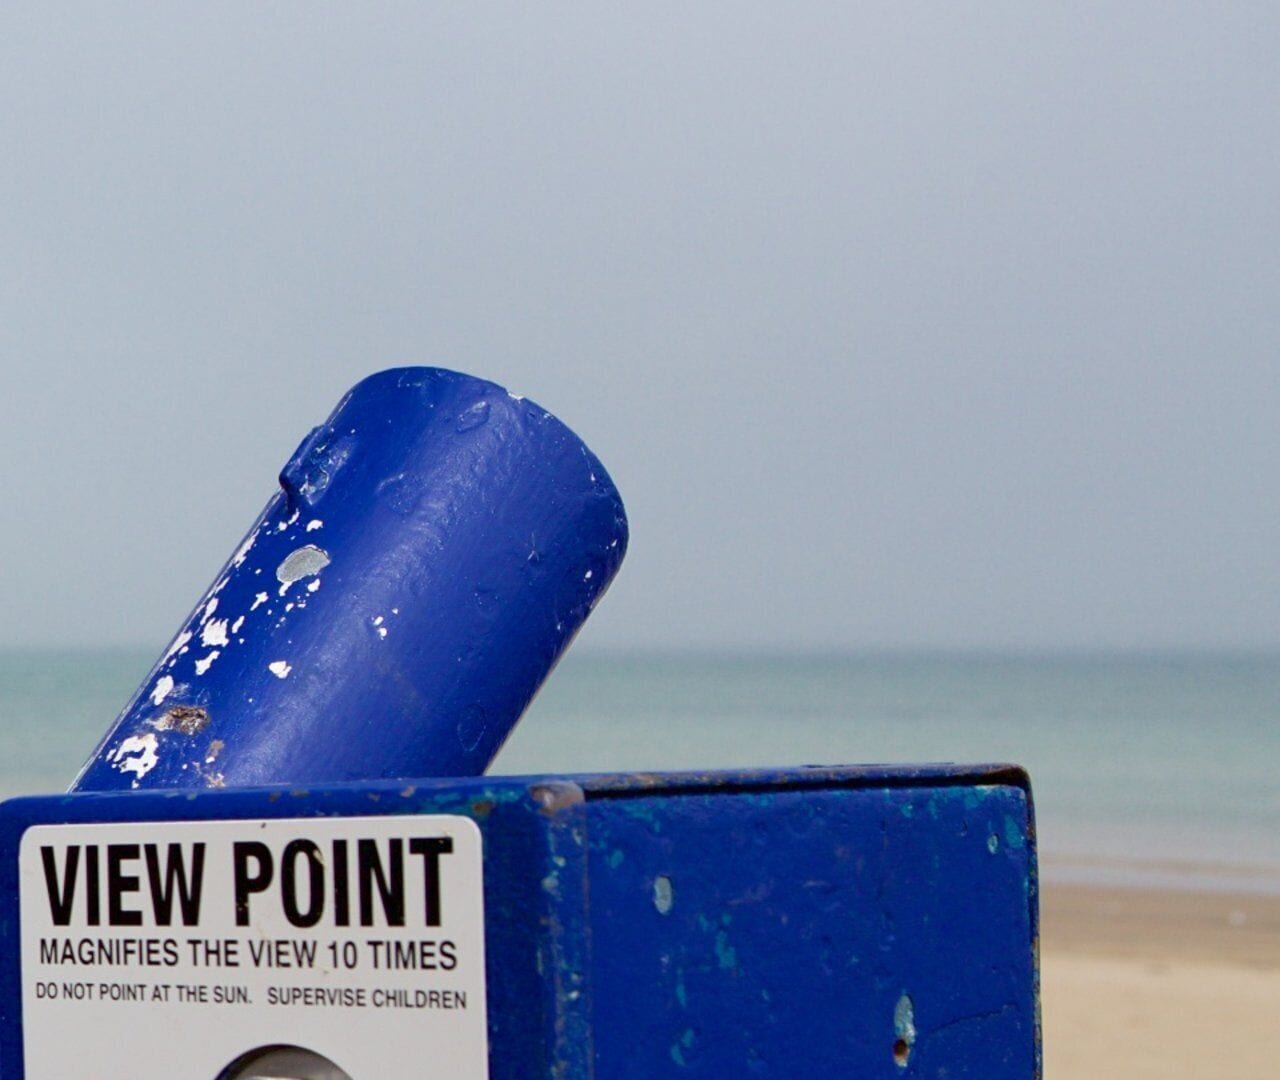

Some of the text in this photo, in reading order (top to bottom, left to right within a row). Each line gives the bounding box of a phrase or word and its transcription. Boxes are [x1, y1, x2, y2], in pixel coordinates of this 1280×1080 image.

[40, 837, 453, 928] VIEW POINT
[40, 939, 457, 971] MAGNIFIES THE VIEW 10 TIMES
[36, 982, 467, 1009] DO NOT POINT AT THE SUN. SUPERVISE CHILDREN
